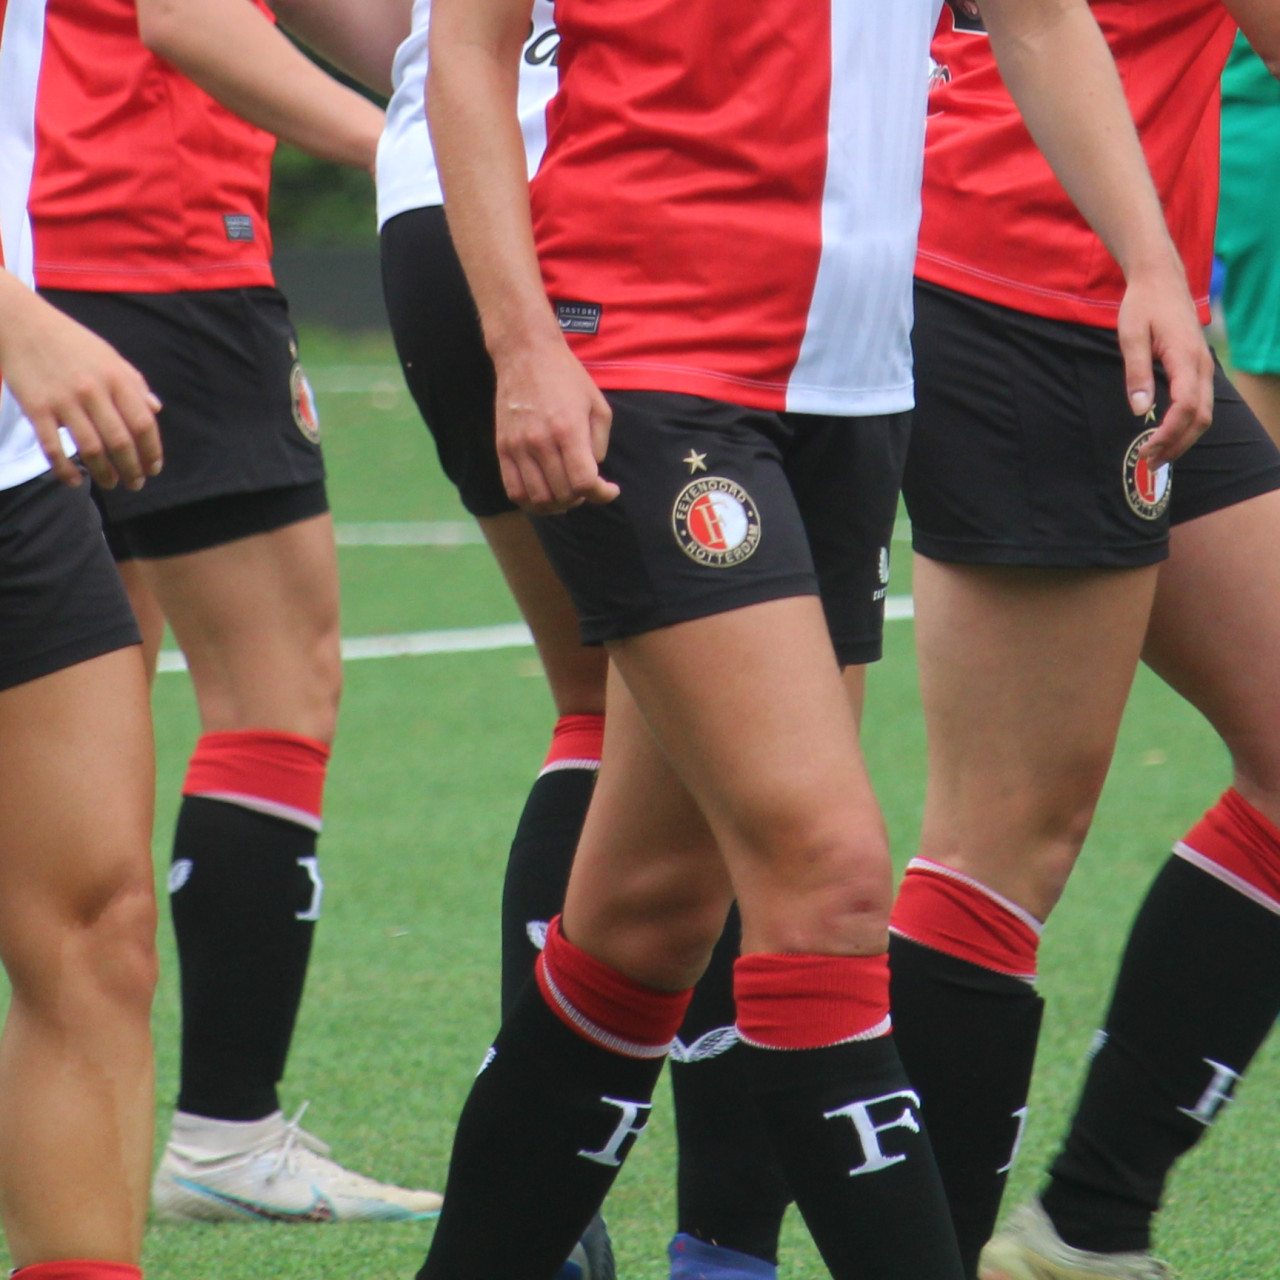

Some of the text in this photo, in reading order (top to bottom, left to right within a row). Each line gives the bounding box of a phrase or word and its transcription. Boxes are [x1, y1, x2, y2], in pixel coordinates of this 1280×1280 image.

[676, 480, 746, 521] FEYENOORD
[686, 524, 759, 565] ROTTERDAM
[823, 1089, 921, 1177] F
